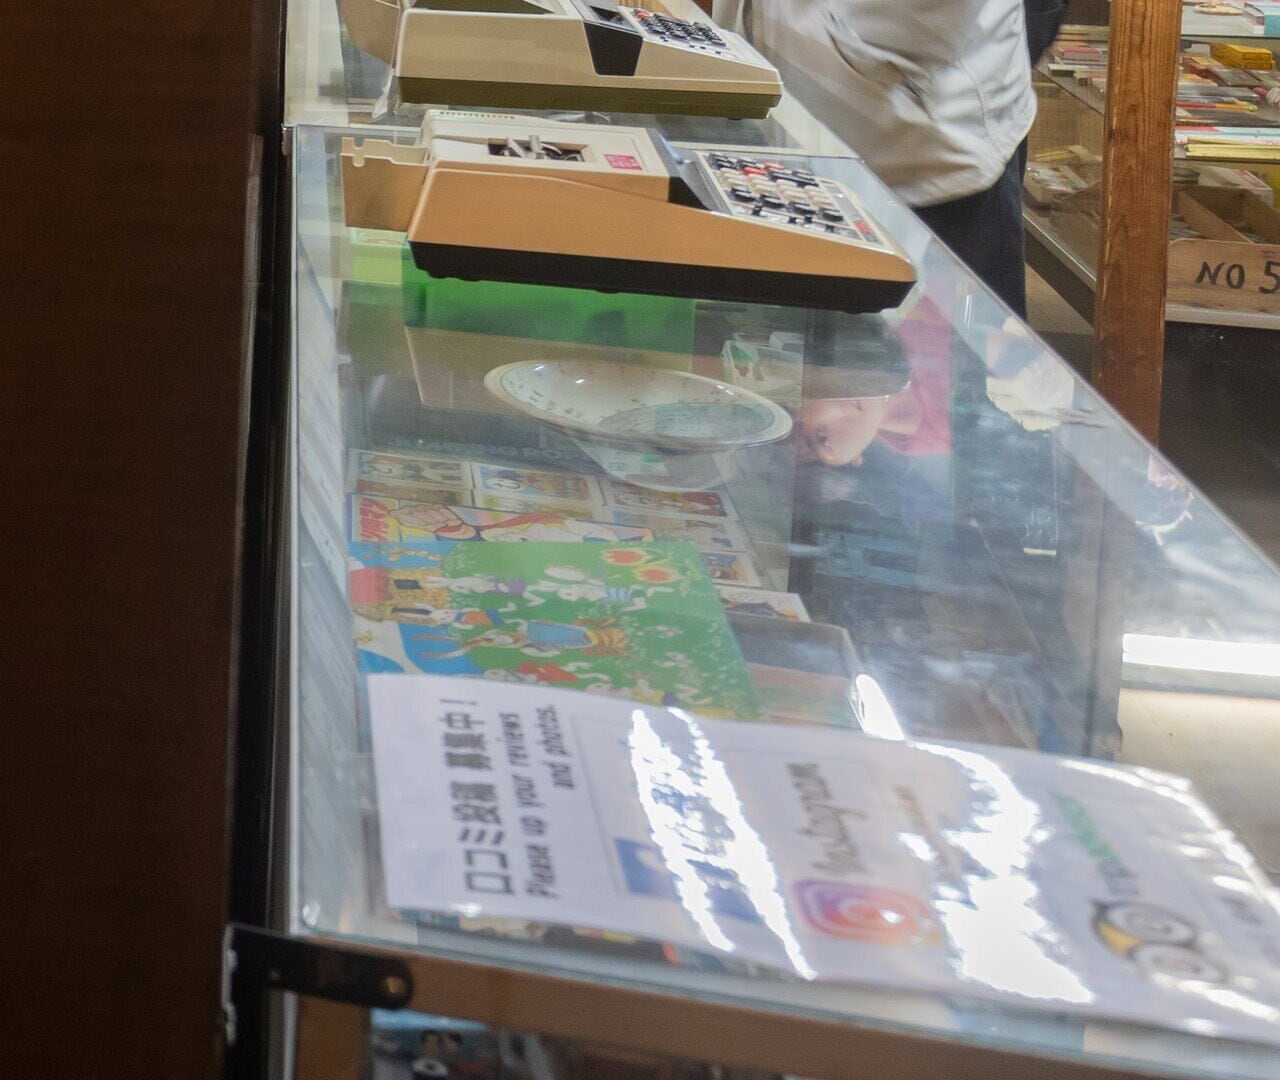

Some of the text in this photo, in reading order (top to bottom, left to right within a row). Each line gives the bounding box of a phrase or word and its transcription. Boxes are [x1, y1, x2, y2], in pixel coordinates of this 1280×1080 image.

[1195, 261, 1245, 289] NO
[536, 703, 576, 790] and photos.
[450, 780, 516, 896] 口コミ投稿
[496, 712, 560, 899] Please up your reviews
